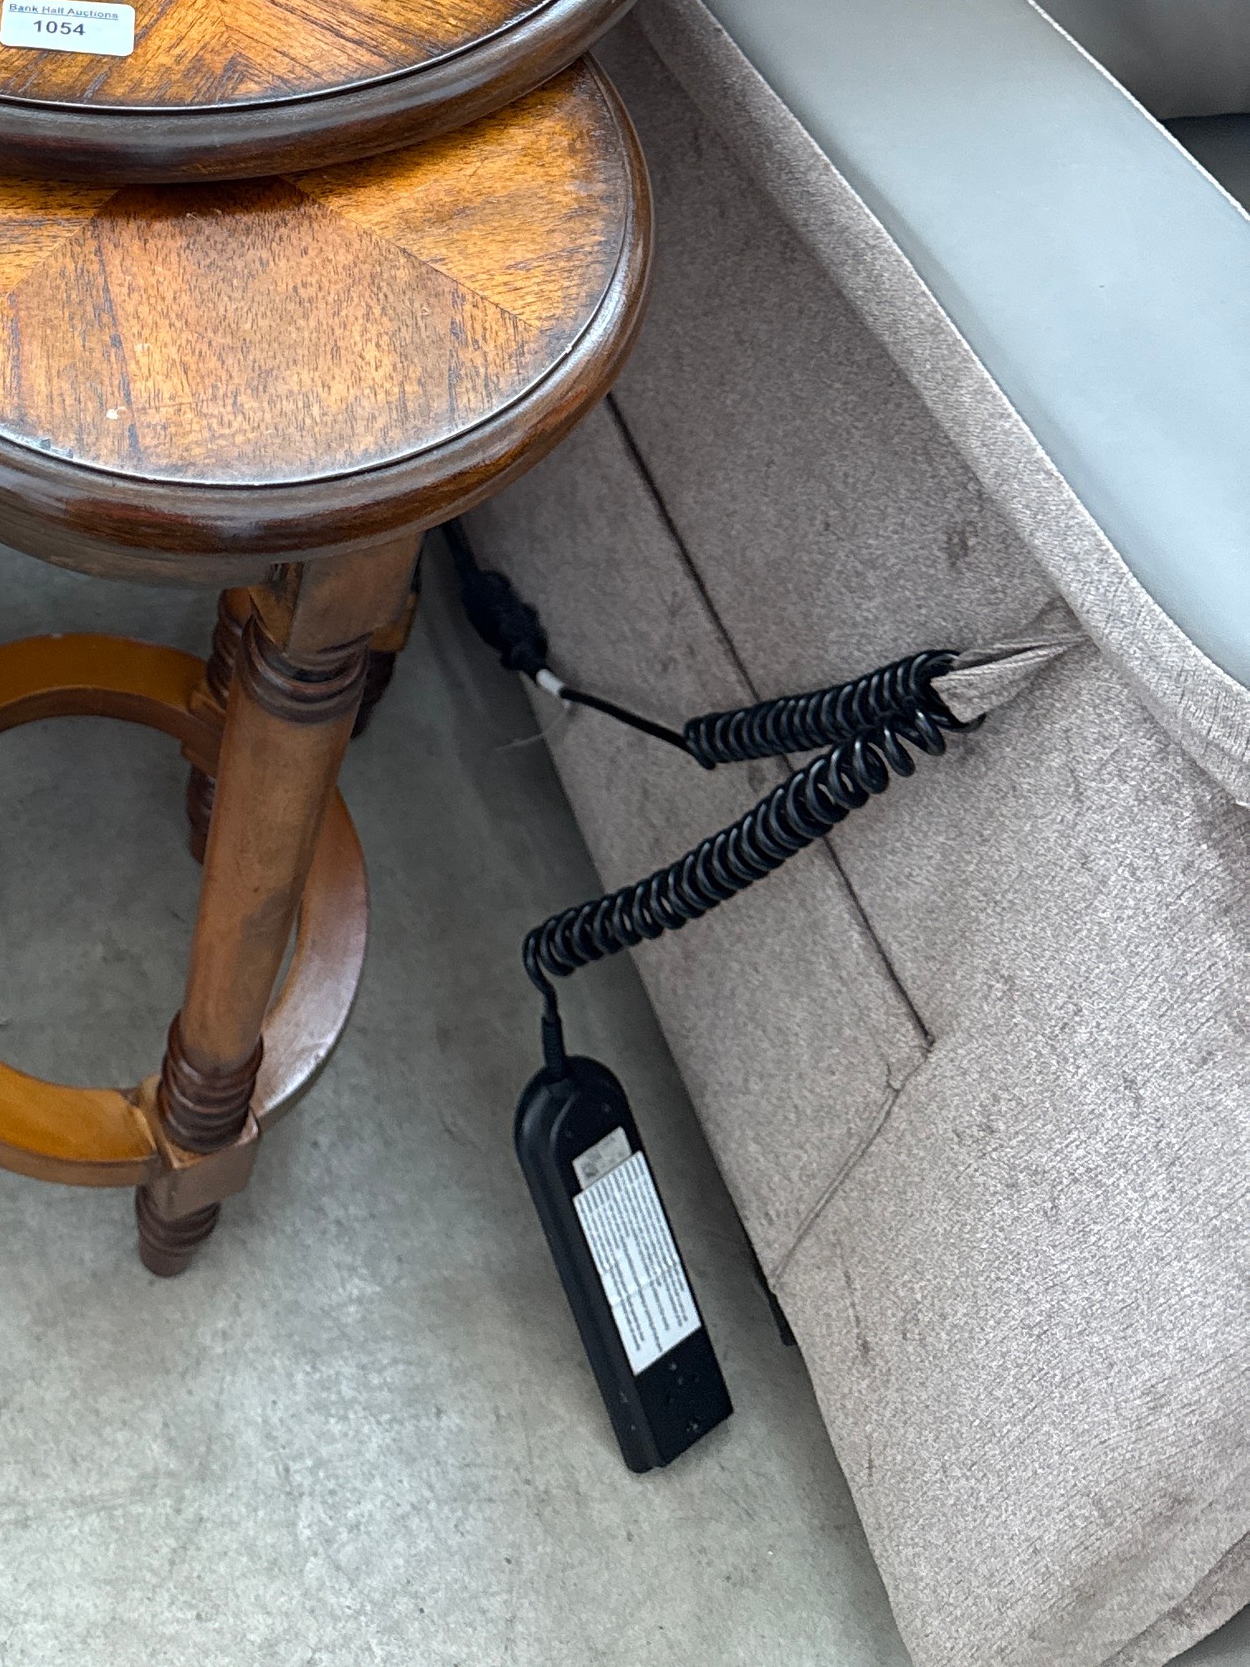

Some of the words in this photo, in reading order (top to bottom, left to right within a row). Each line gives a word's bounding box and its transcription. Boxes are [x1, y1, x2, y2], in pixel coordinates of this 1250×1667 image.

[9, 3, 38, 12] Bank
[42, 5, 64, 14] Hall
[67, 8, 119, 19] Auctions
[33, 20, 86, 36] 1054
